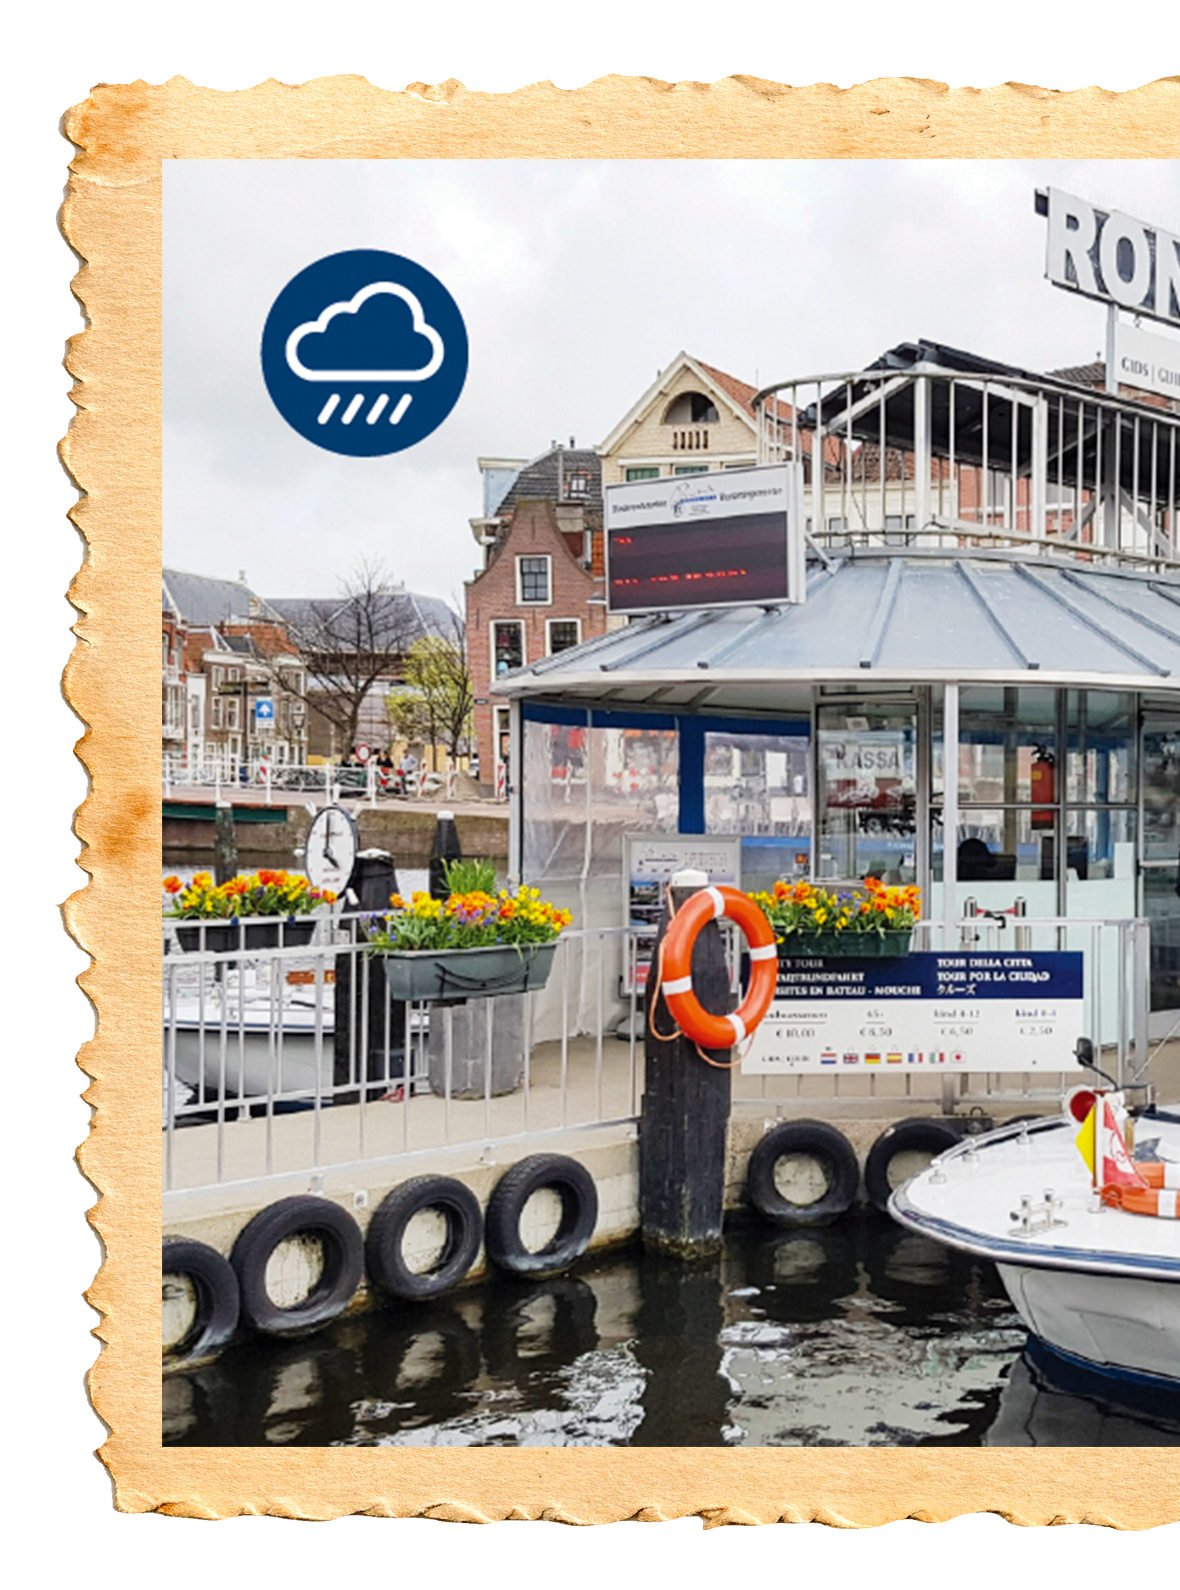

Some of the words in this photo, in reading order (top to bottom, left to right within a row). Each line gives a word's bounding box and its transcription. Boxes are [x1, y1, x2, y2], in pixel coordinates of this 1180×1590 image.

[1121, 356, 1149, 377] GIDS
[836, 749, 899, 770] KASSA
[936, 958, 967, 968] TOUR
[968, 958, 1002, 968] DELLA
[936, 971, 967, 981] TOUR
[968, 971, 992, 981] POR
[993, 971, 1007, 981] LA
[809, 985, 824, 996] EN
[826, 985, 867, 996] BATEAU
[874, 985, 922, 996] MOUCHE
